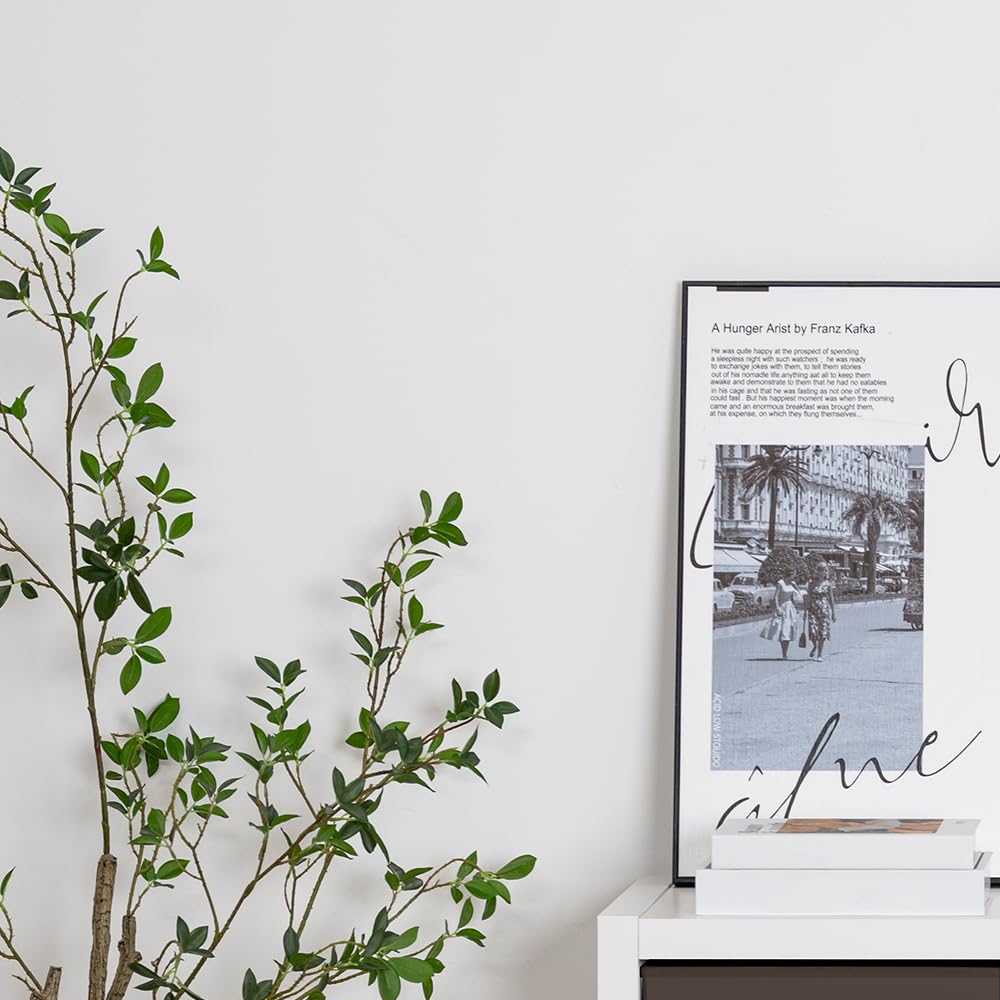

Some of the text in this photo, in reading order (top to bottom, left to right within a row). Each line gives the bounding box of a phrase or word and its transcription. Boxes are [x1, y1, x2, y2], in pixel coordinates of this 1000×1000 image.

[711, 323, 876, 337] A Hunger Arist by Franz Kafka
